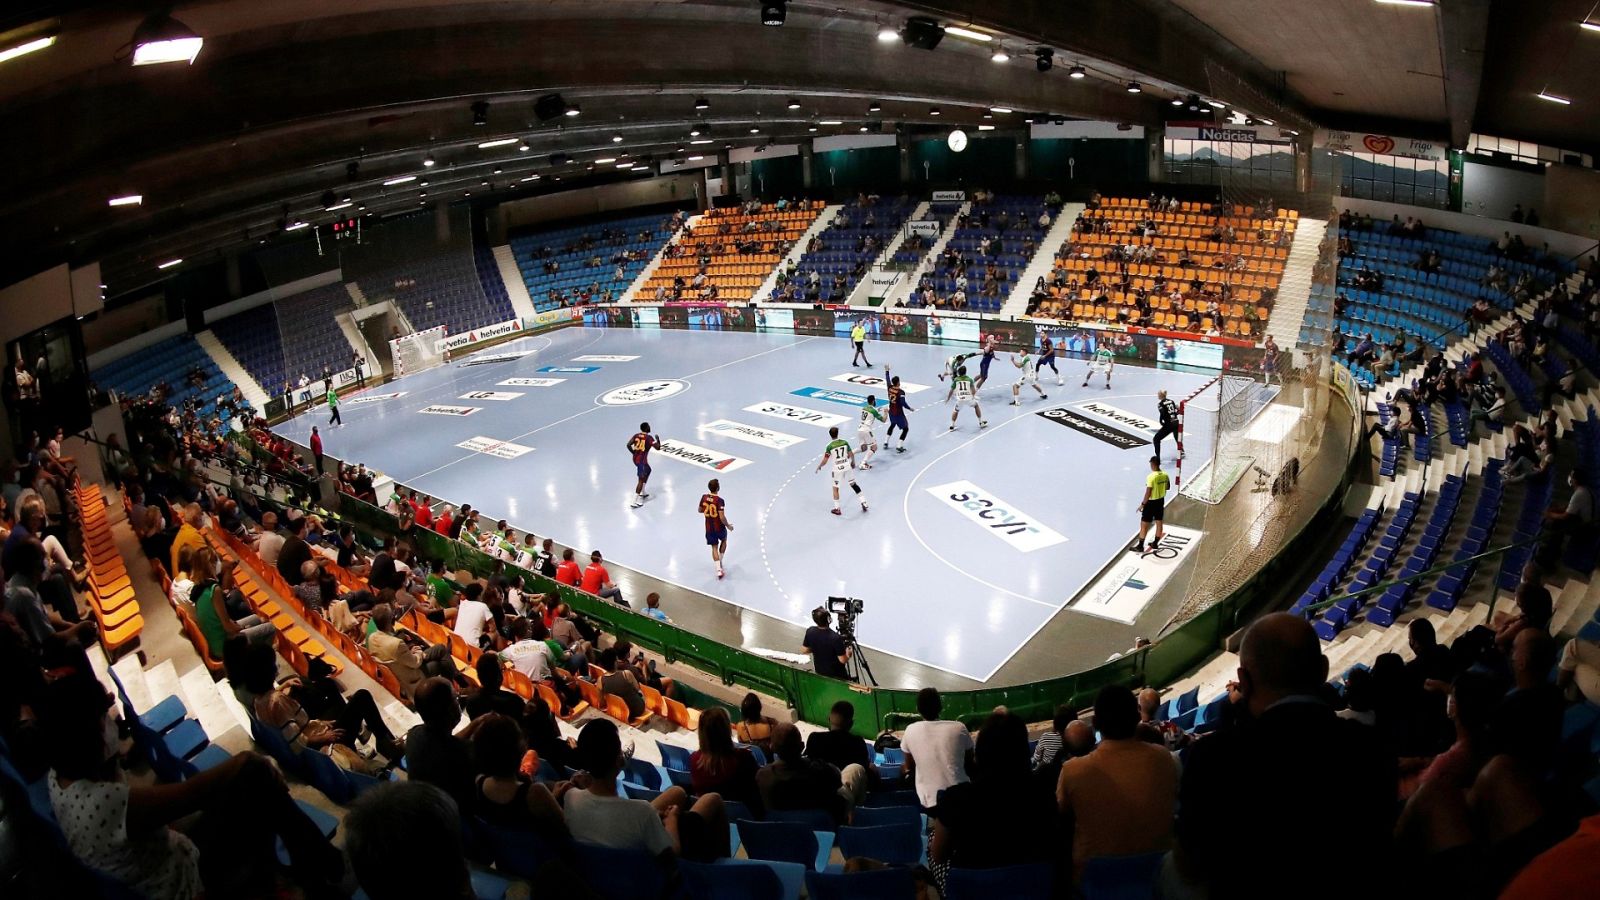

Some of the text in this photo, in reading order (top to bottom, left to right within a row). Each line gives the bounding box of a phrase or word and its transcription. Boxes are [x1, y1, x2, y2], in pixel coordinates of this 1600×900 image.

[1203, 128, 1255, 142] Noticias
[1410, 140, 1432, 153] Frigo
[872, 278, 894, 286] helvetia
[480, 325, 511, 340] helvetia
[959, 381, 967, 391] 11
[1083, 402, 1151, 430] helvetia
[631, 437, 646, 452] 24
[660, 442, 712, 465] helvetia
[835, 446, 845, 459] 17
[702, 502, 719, 518] 20
[950, 491, 1041, 535] sacyr
[1140, 533, 1192, 560] IMQ
[534, 557, 545, 570] 16
